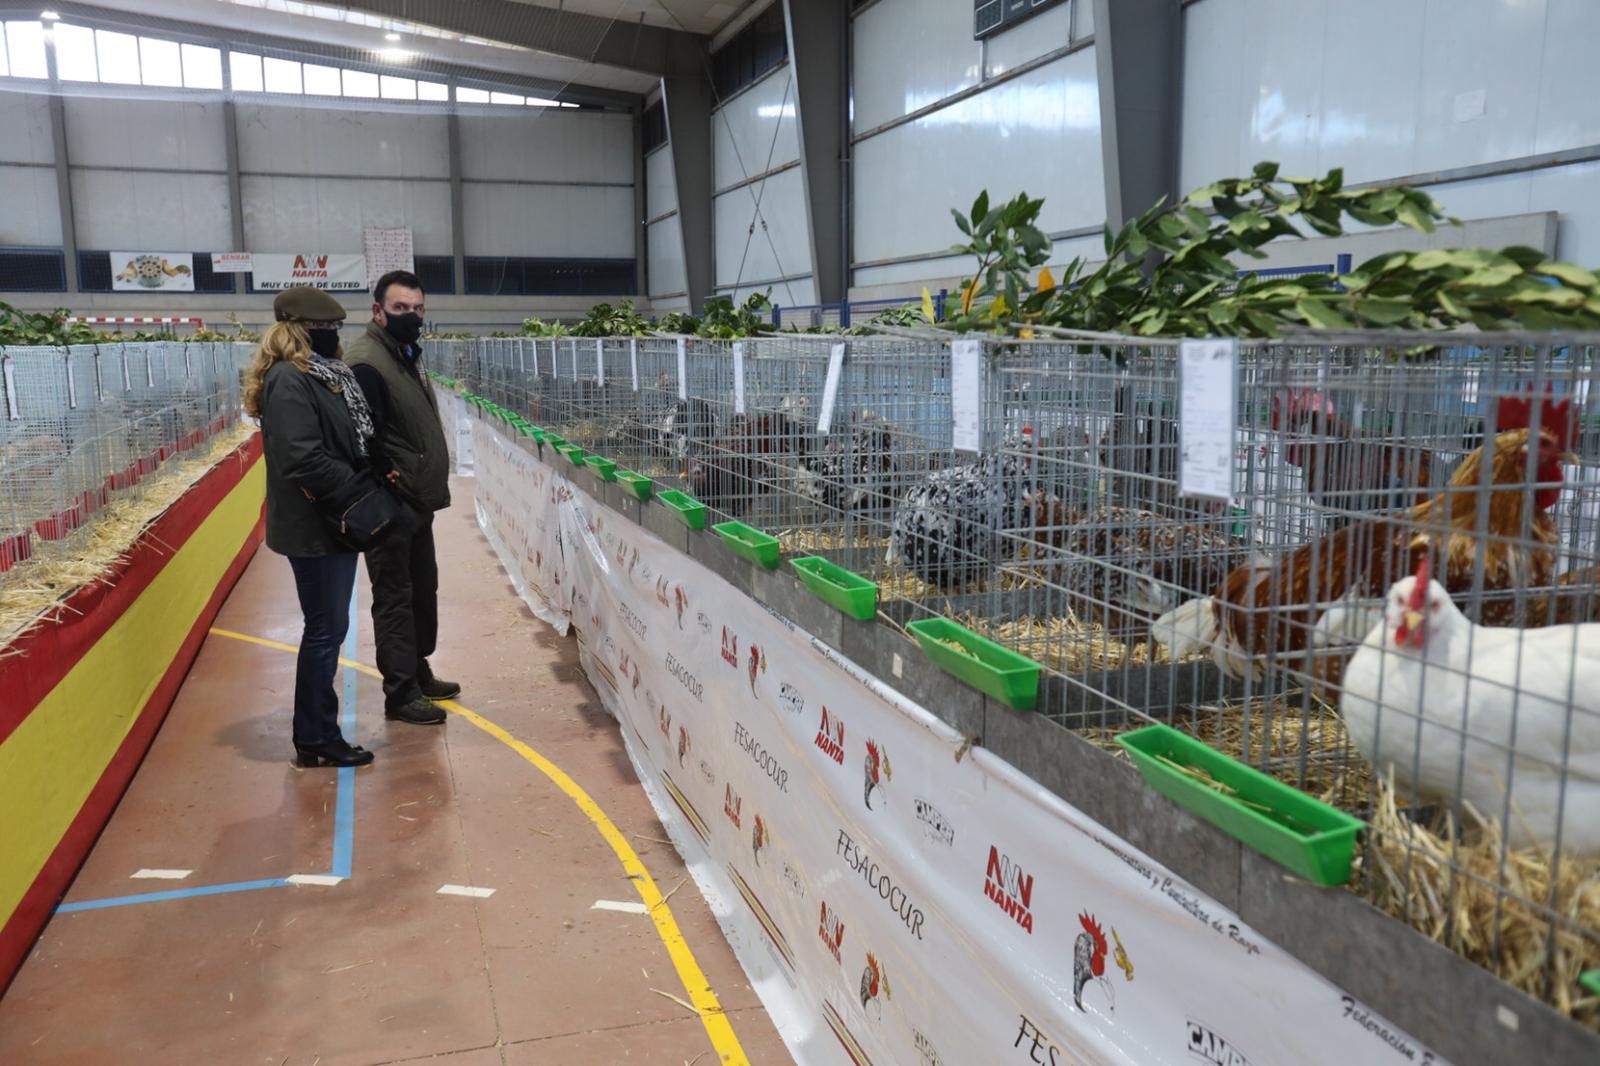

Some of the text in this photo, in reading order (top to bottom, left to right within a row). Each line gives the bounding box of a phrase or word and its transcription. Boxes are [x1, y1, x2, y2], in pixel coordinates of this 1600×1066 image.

[261, 281, 282, 289] MUY
[316, 281, 328, 289] DE
[331, 281, 360, 289] USTED
[292, 270, 328, 278] NANTA
[665, 652, 704, 703] FESACOCUR
[734, 722, 789, 793] FESACOCUR
[815, 731, 844, 766] NANTA
[837, 829, 925, 940] FESACOCUR
[984, 878, 1033, 935] NANTA
